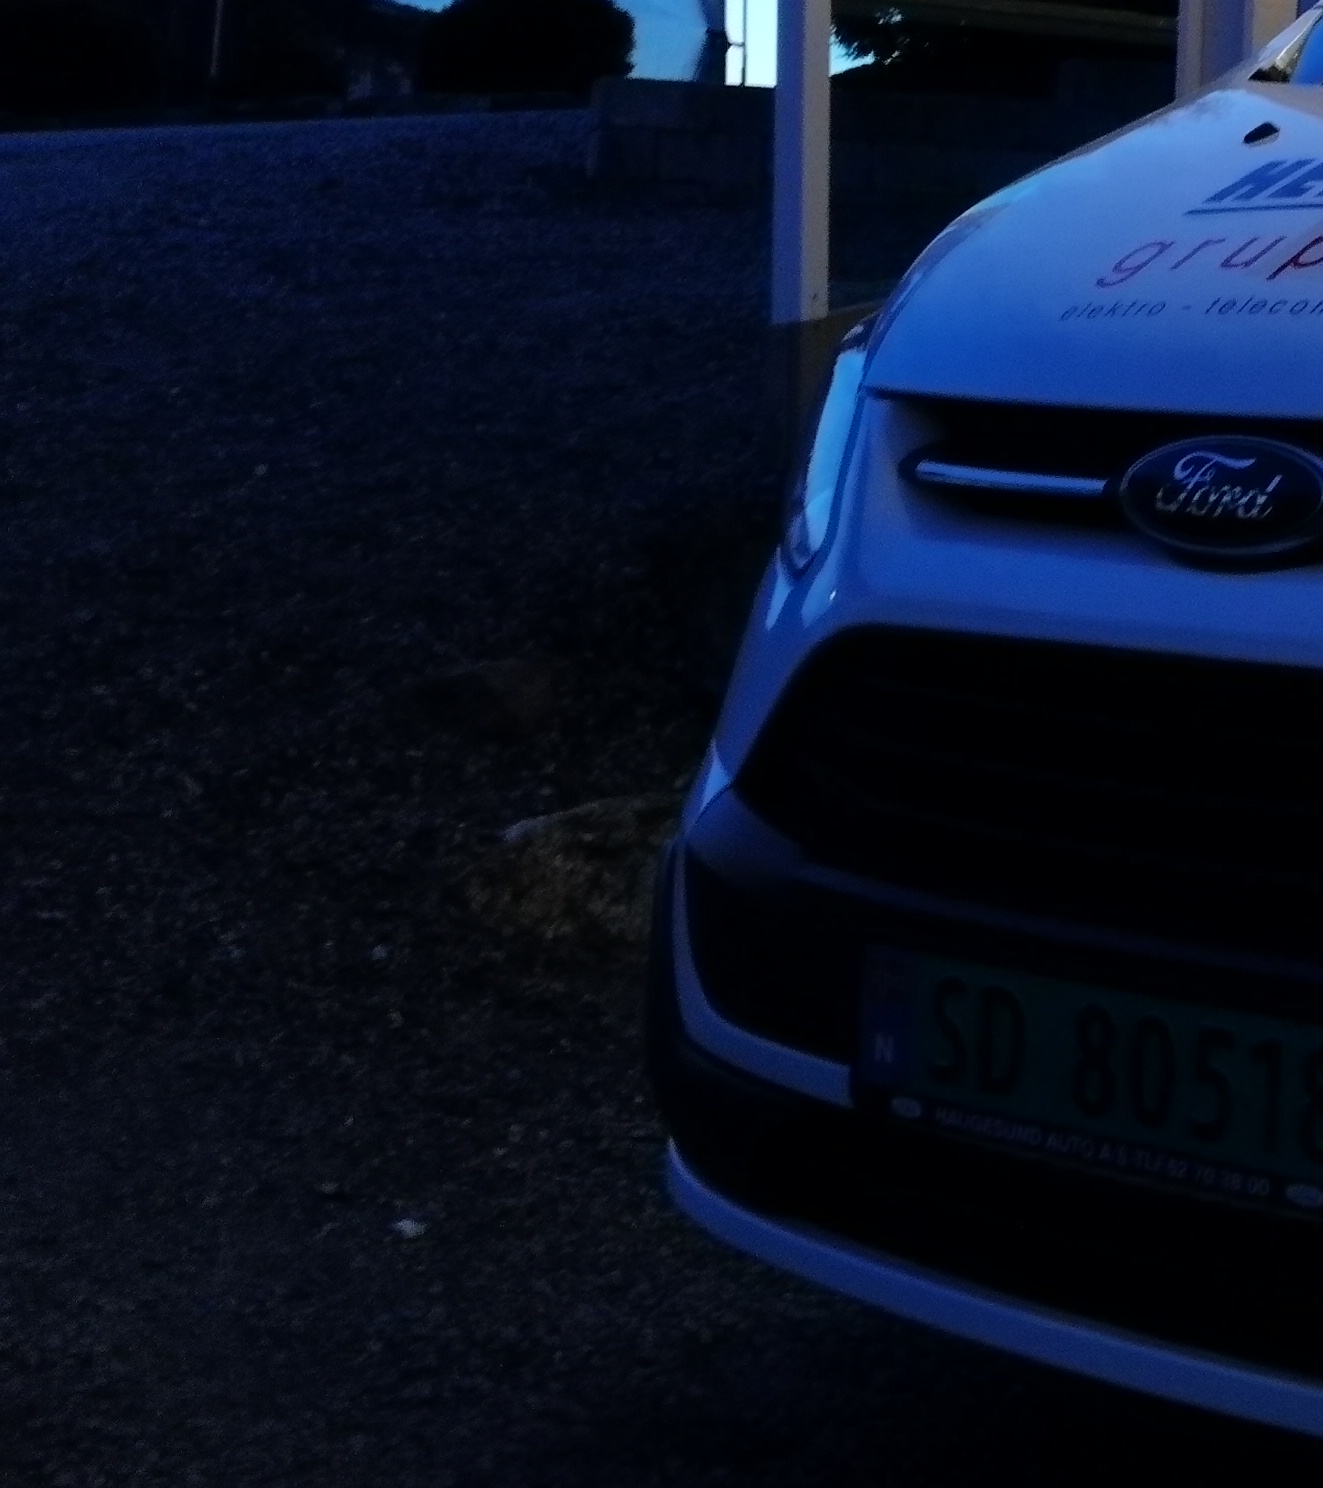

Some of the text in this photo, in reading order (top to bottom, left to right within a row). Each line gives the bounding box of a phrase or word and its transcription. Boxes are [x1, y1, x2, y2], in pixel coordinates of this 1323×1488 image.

[1060, 296, 1168, 322] elektro
[1154, 450, 1284, 521] Ford
[932, 976, 1025, 1093] SD
[1045, 1129, 1095, 1159] AUTO
